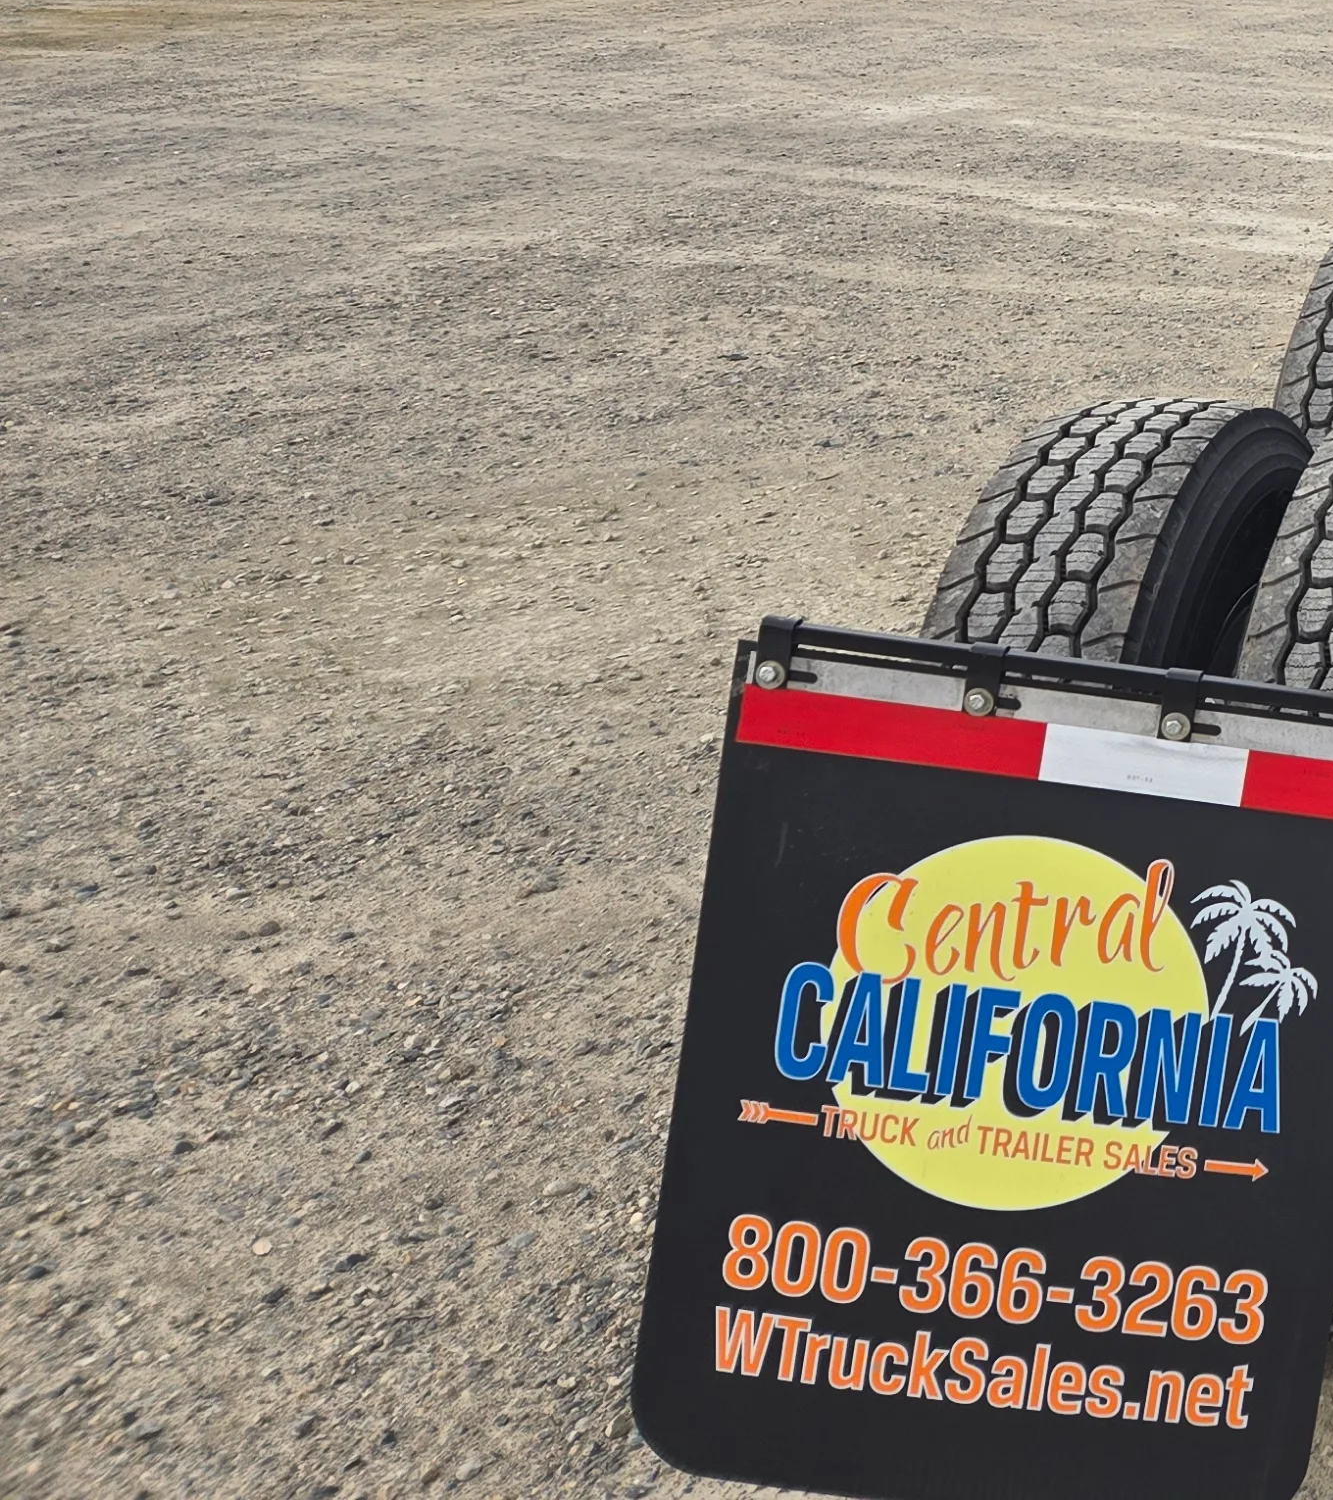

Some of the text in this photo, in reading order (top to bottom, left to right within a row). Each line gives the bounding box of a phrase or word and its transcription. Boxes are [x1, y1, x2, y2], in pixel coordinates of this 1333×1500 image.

[836, 857, 1176, 986] Central
[773, 961, 1282, 1135] CALIFORNIA
[820, 1104, 1199, 1181] TRUCK and TRAILER SALES
[721, 1214, 1269, 1346] 800-366-3263
[713, 1305, 1256, 1430] WTruckSales.net
